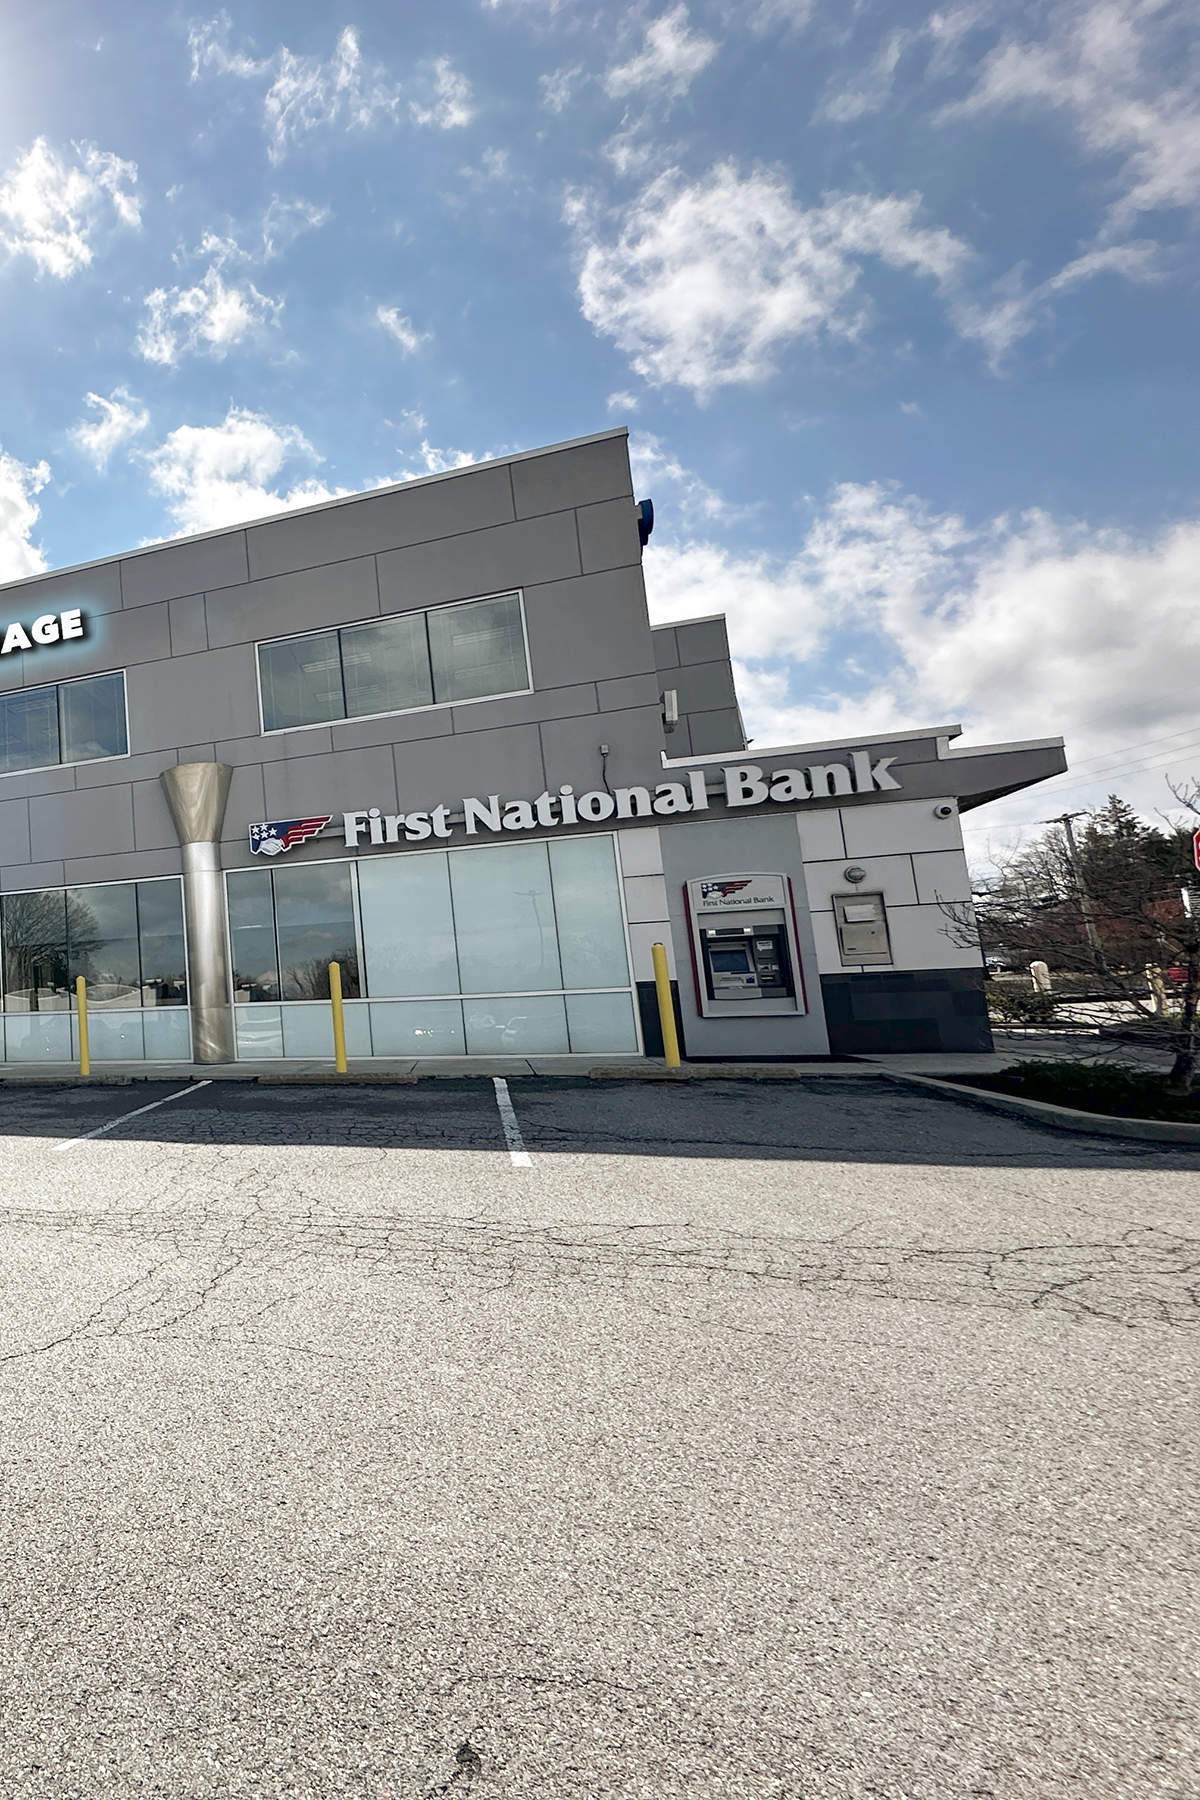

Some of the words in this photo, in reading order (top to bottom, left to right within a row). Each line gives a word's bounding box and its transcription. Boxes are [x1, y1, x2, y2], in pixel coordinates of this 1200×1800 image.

[342, 804, 453, 848] First
[462, 770, 709, 835] National
[721, 750, 902, 808] Bank
[719, 897, 752, 906] National
[753, 896, 775, 904] Bank
